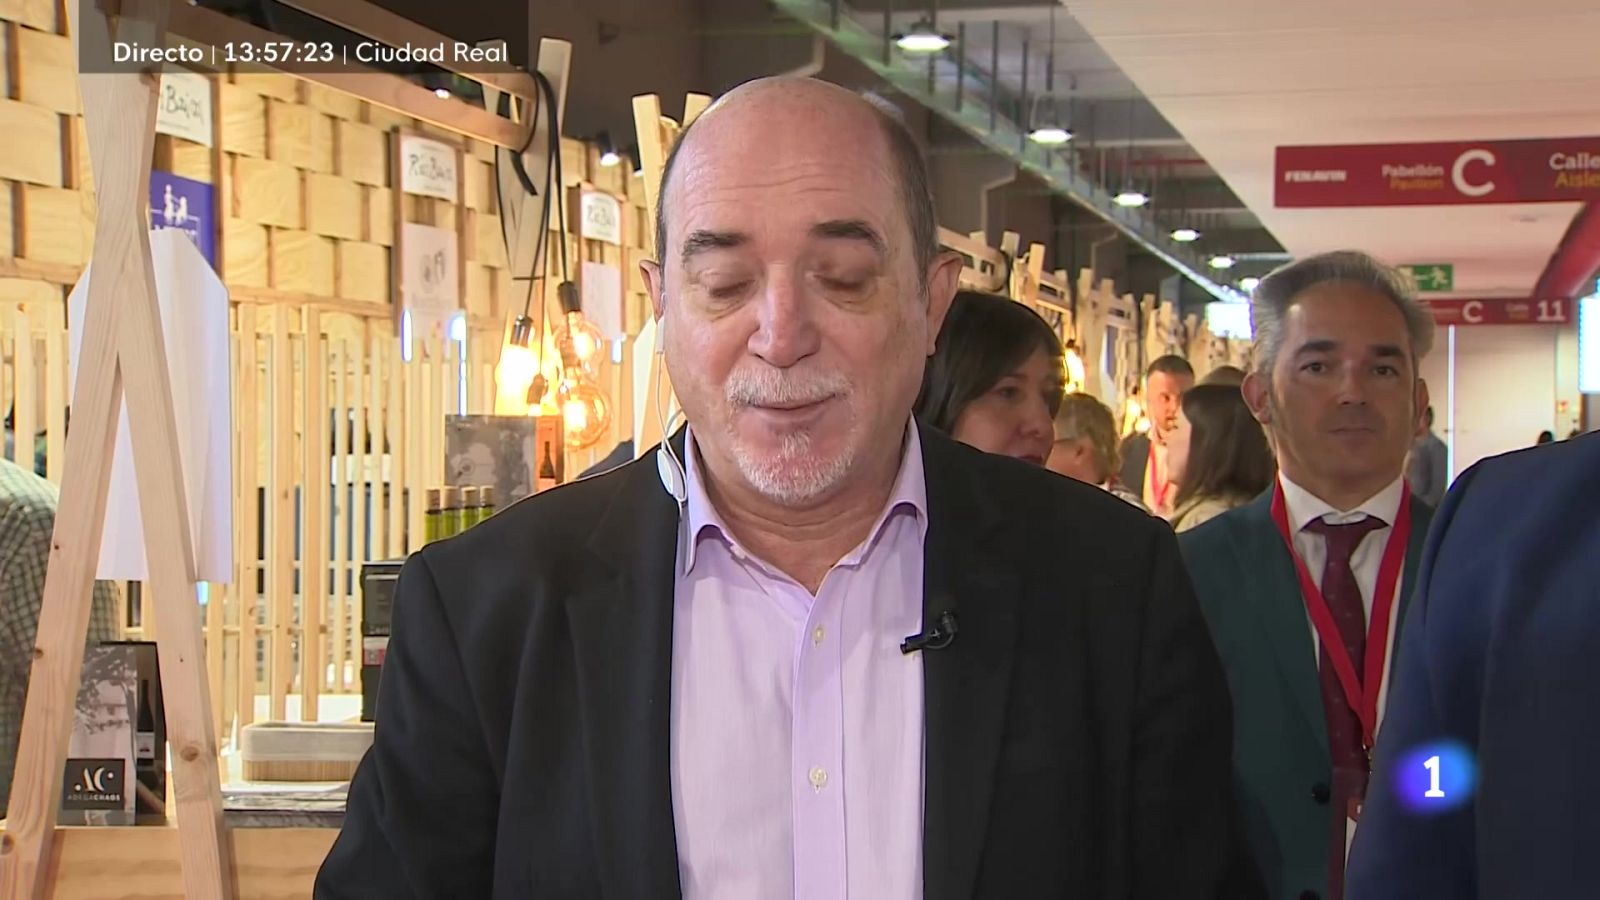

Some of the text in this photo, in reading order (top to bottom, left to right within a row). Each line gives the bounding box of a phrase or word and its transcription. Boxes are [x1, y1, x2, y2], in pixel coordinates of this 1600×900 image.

[1382, 163, 1444, 178] Pabellón
[1451, 149, 1496, 197] C
[1462, 300, 1484, 323] C
[1536, 300, 1566, 322] 11
